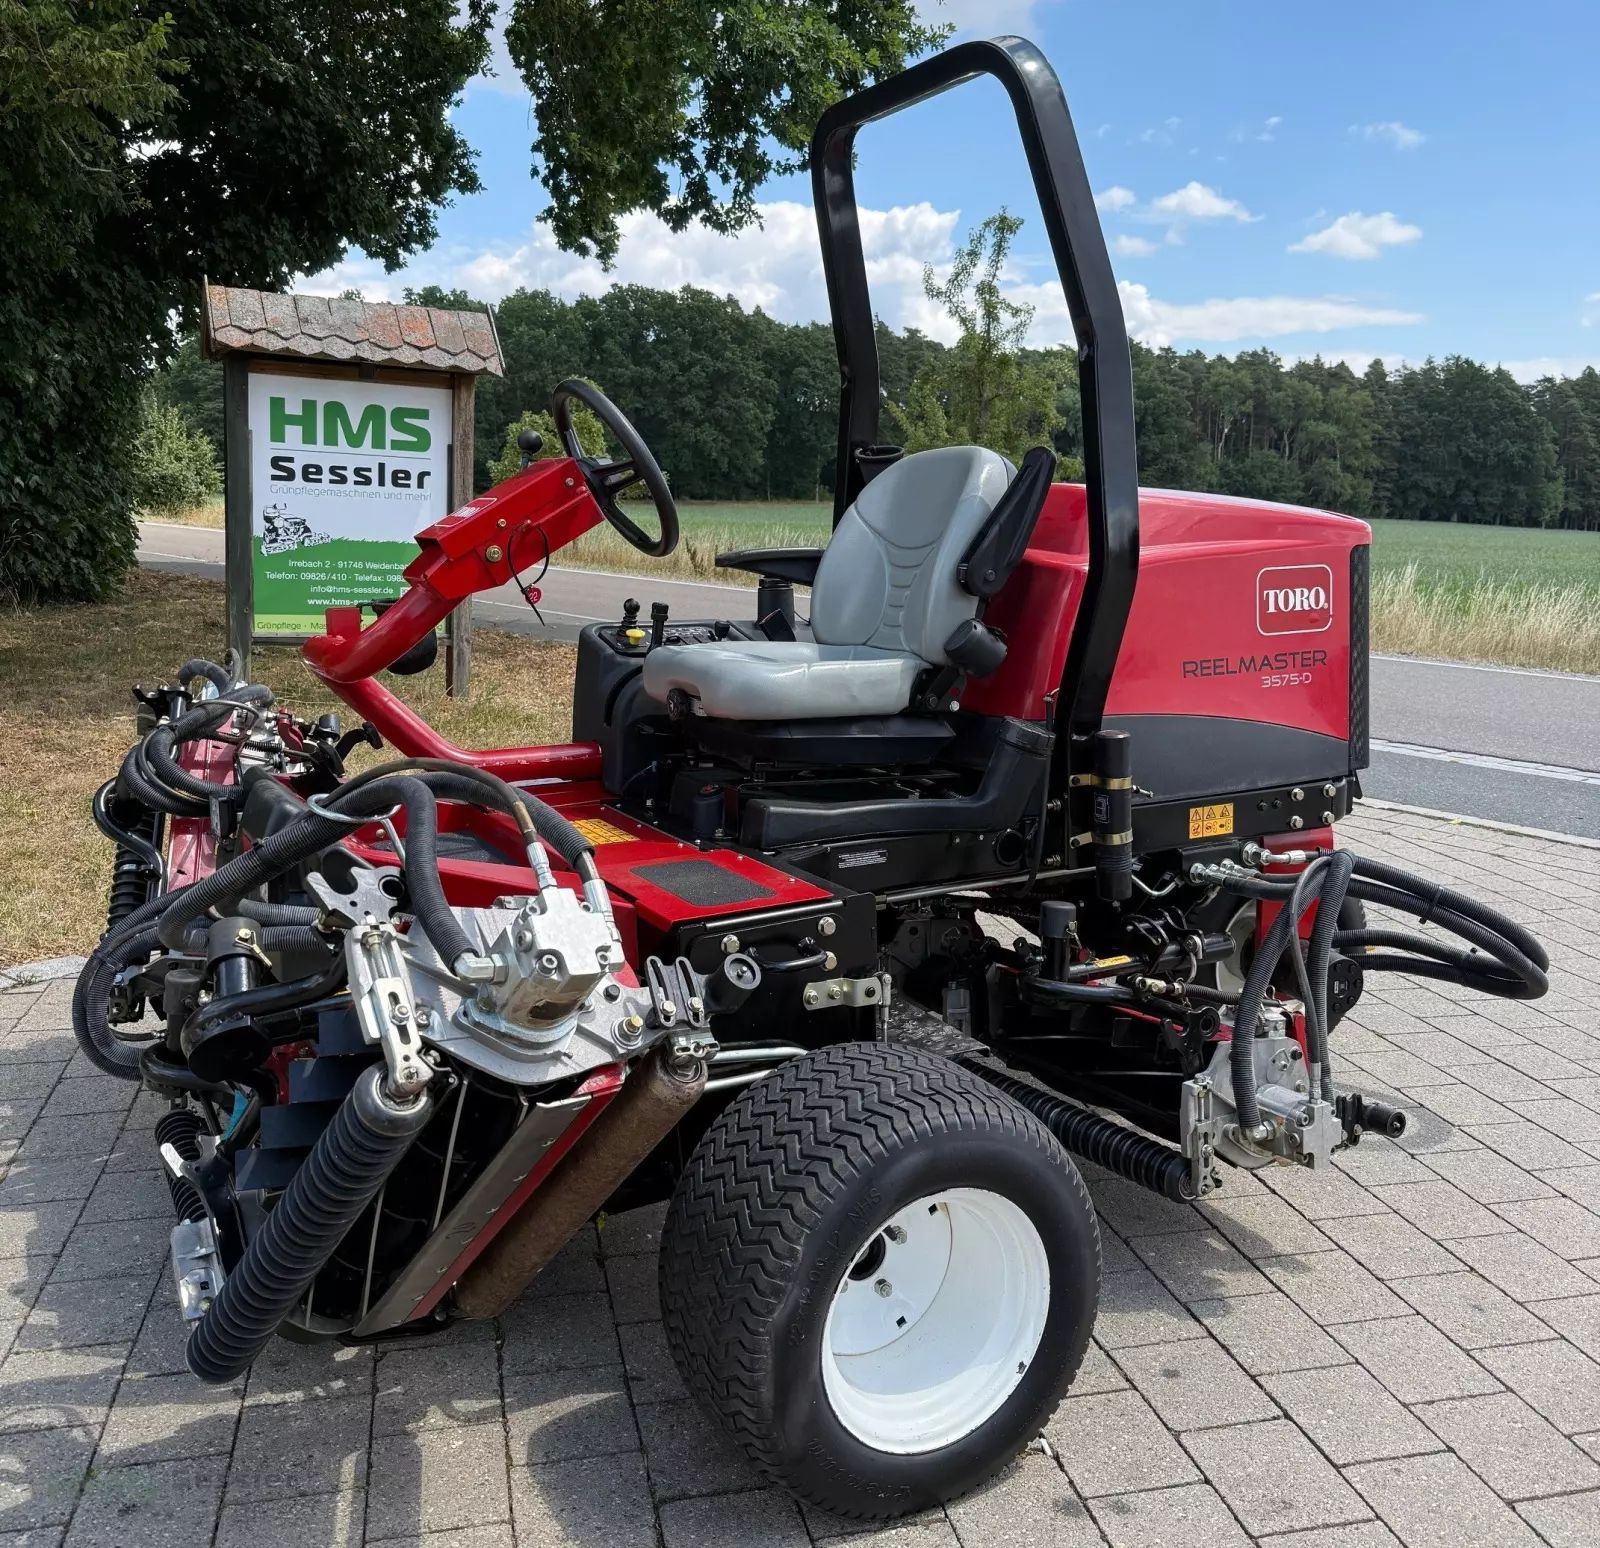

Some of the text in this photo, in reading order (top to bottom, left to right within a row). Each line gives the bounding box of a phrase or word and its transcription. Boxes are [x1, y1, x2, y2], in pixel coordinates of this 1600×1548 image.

[269, 396, 432, 453] HMS
[270, 455, 432, 490] Sessler
[270, 484, 382, 500] Grünpflegemaschinen
[383, 490, 404, 501] und
[288, 559, 323, 568] Irrebach
[324, 560, 331, 568] 2
[265, 571, 298, 580] Telefon:
[353, 573, 385, 582] Telefax:
[310, 585, 394, 594] info@hms-sessler.de
[1263, 586, 1326, 614] TORO
[256, 621, 302, 630] Grünpflege
[1182, 650, 1328, 679] REELMASTER
[1261, 672, 1312, 688] 3575-D
